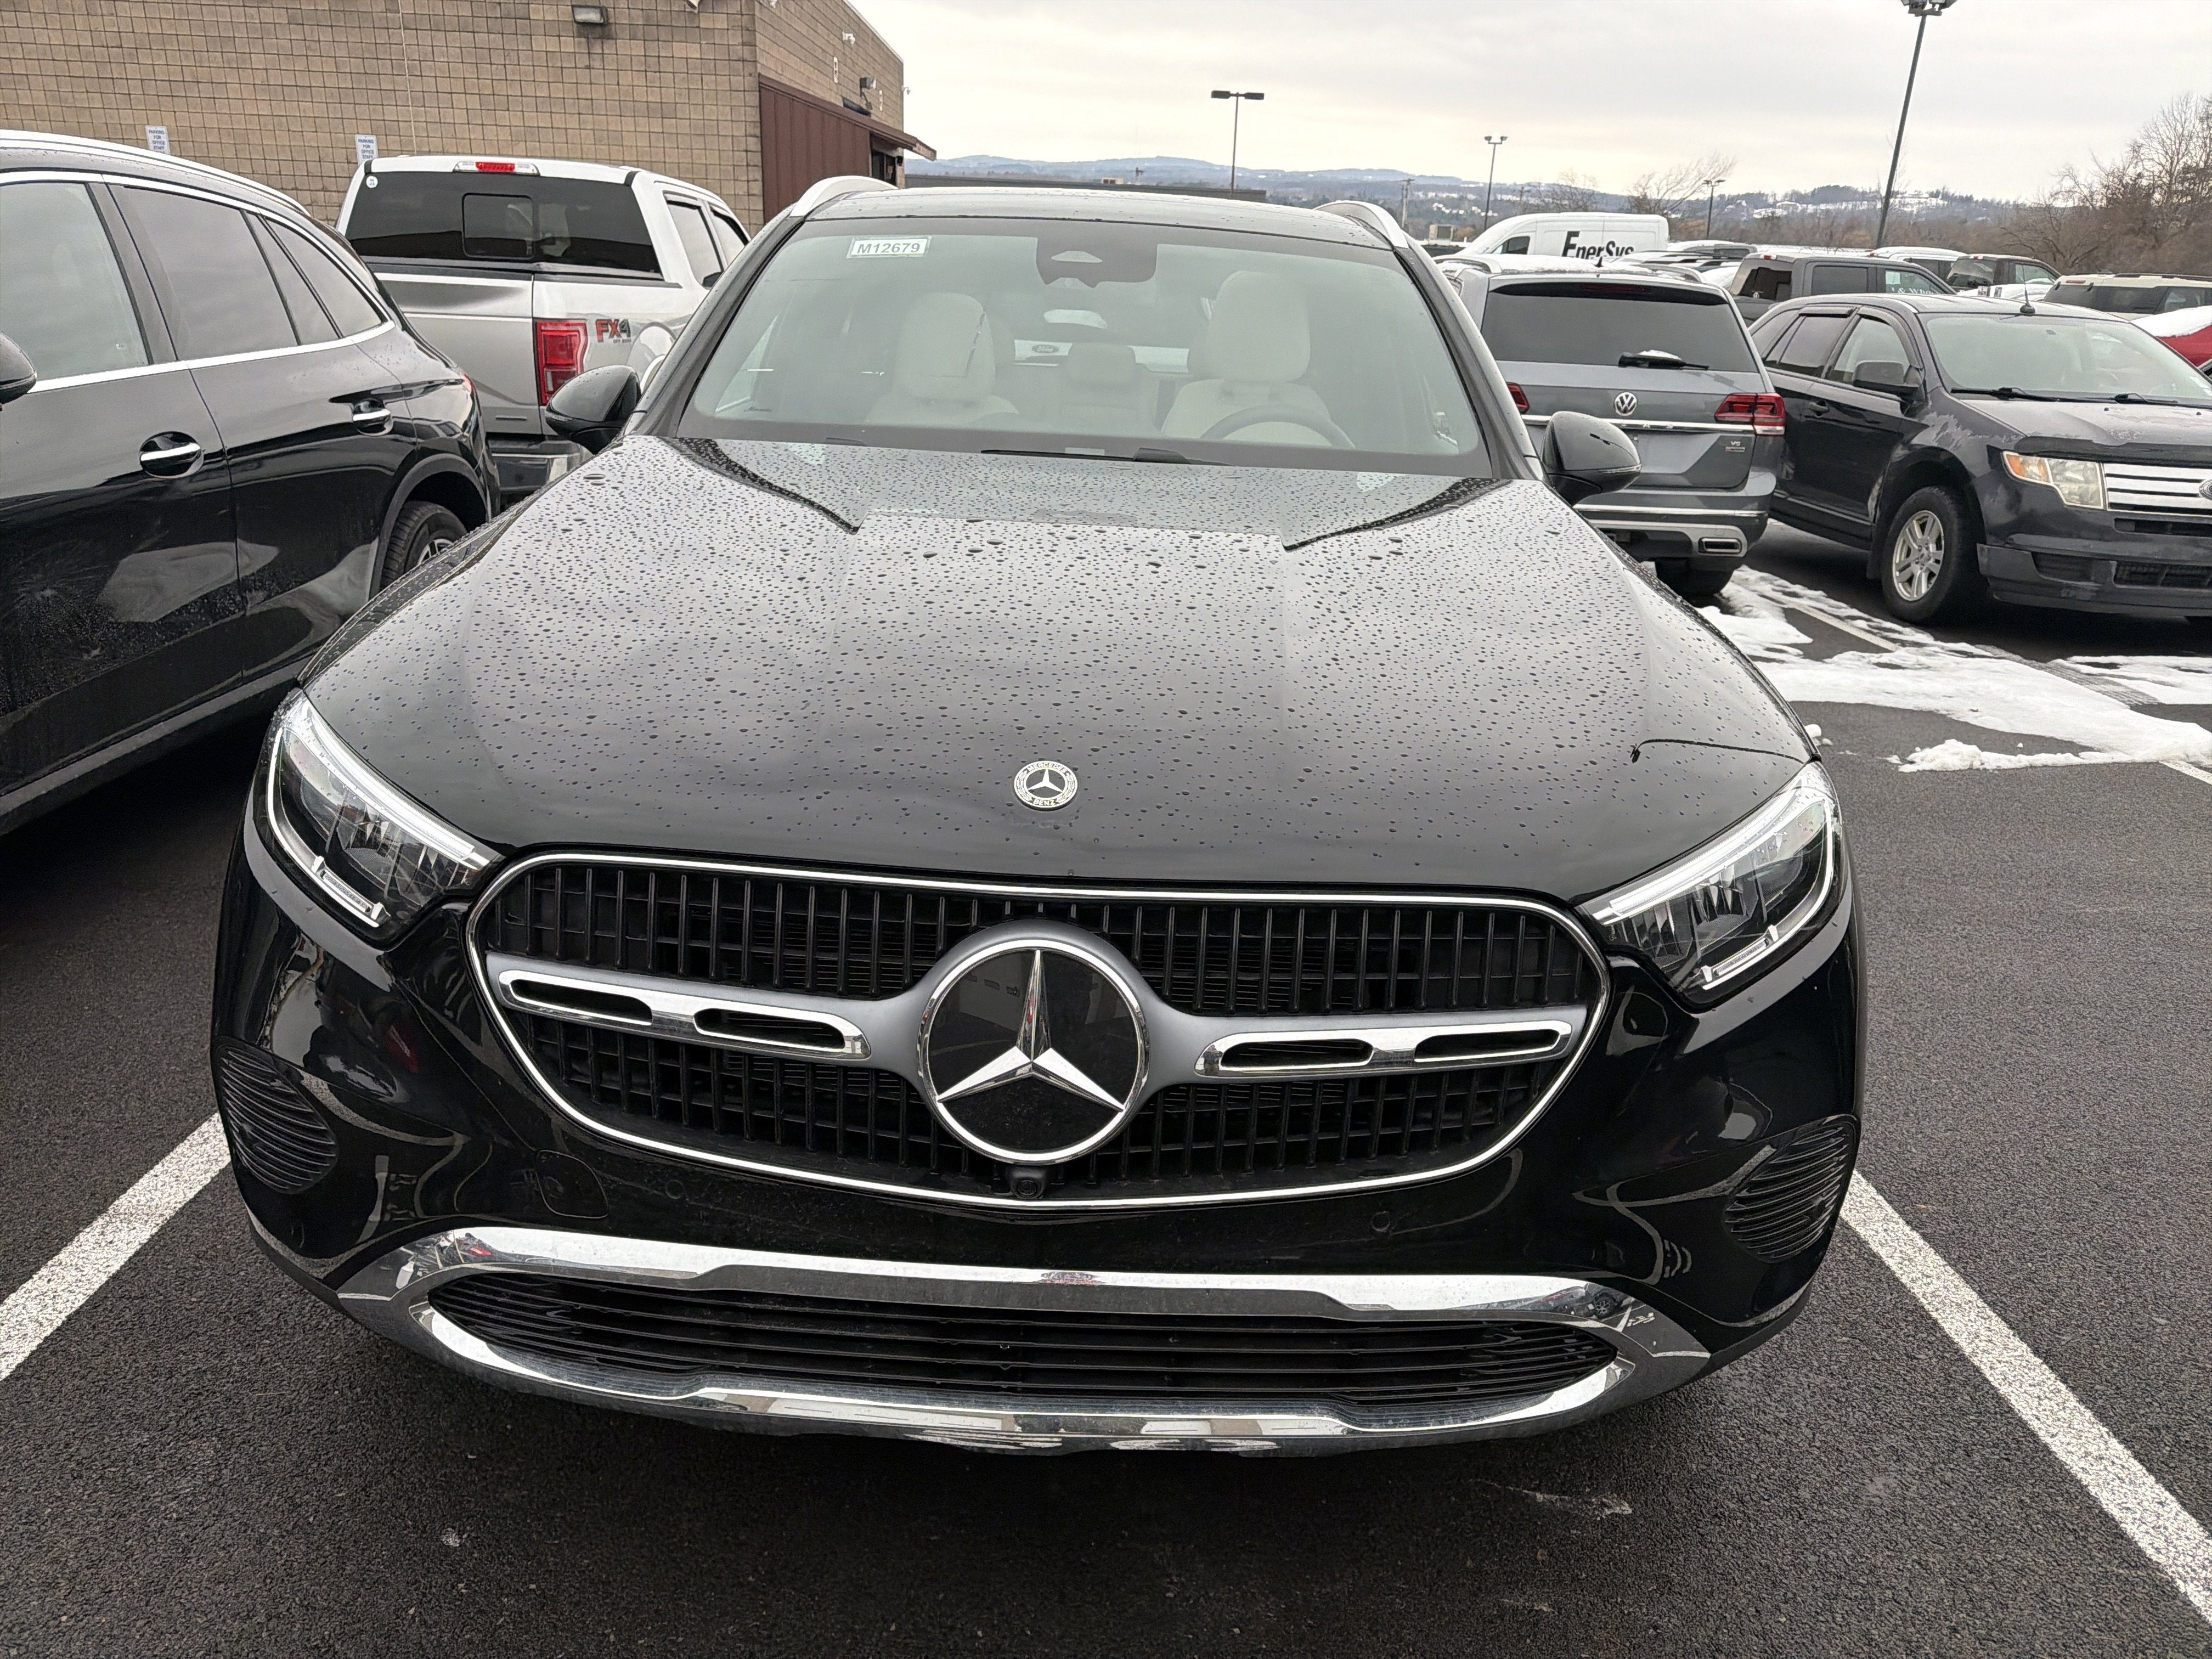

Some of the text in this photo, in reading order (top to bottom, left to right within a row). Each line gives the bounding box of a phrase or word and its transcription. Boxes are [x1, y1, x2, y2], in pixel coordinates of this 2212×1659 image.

[856, 242, 921, 254] M12679
[595, 319, 631, 342] FX4
[1027, 763, 1067, 773] MERCEDES
